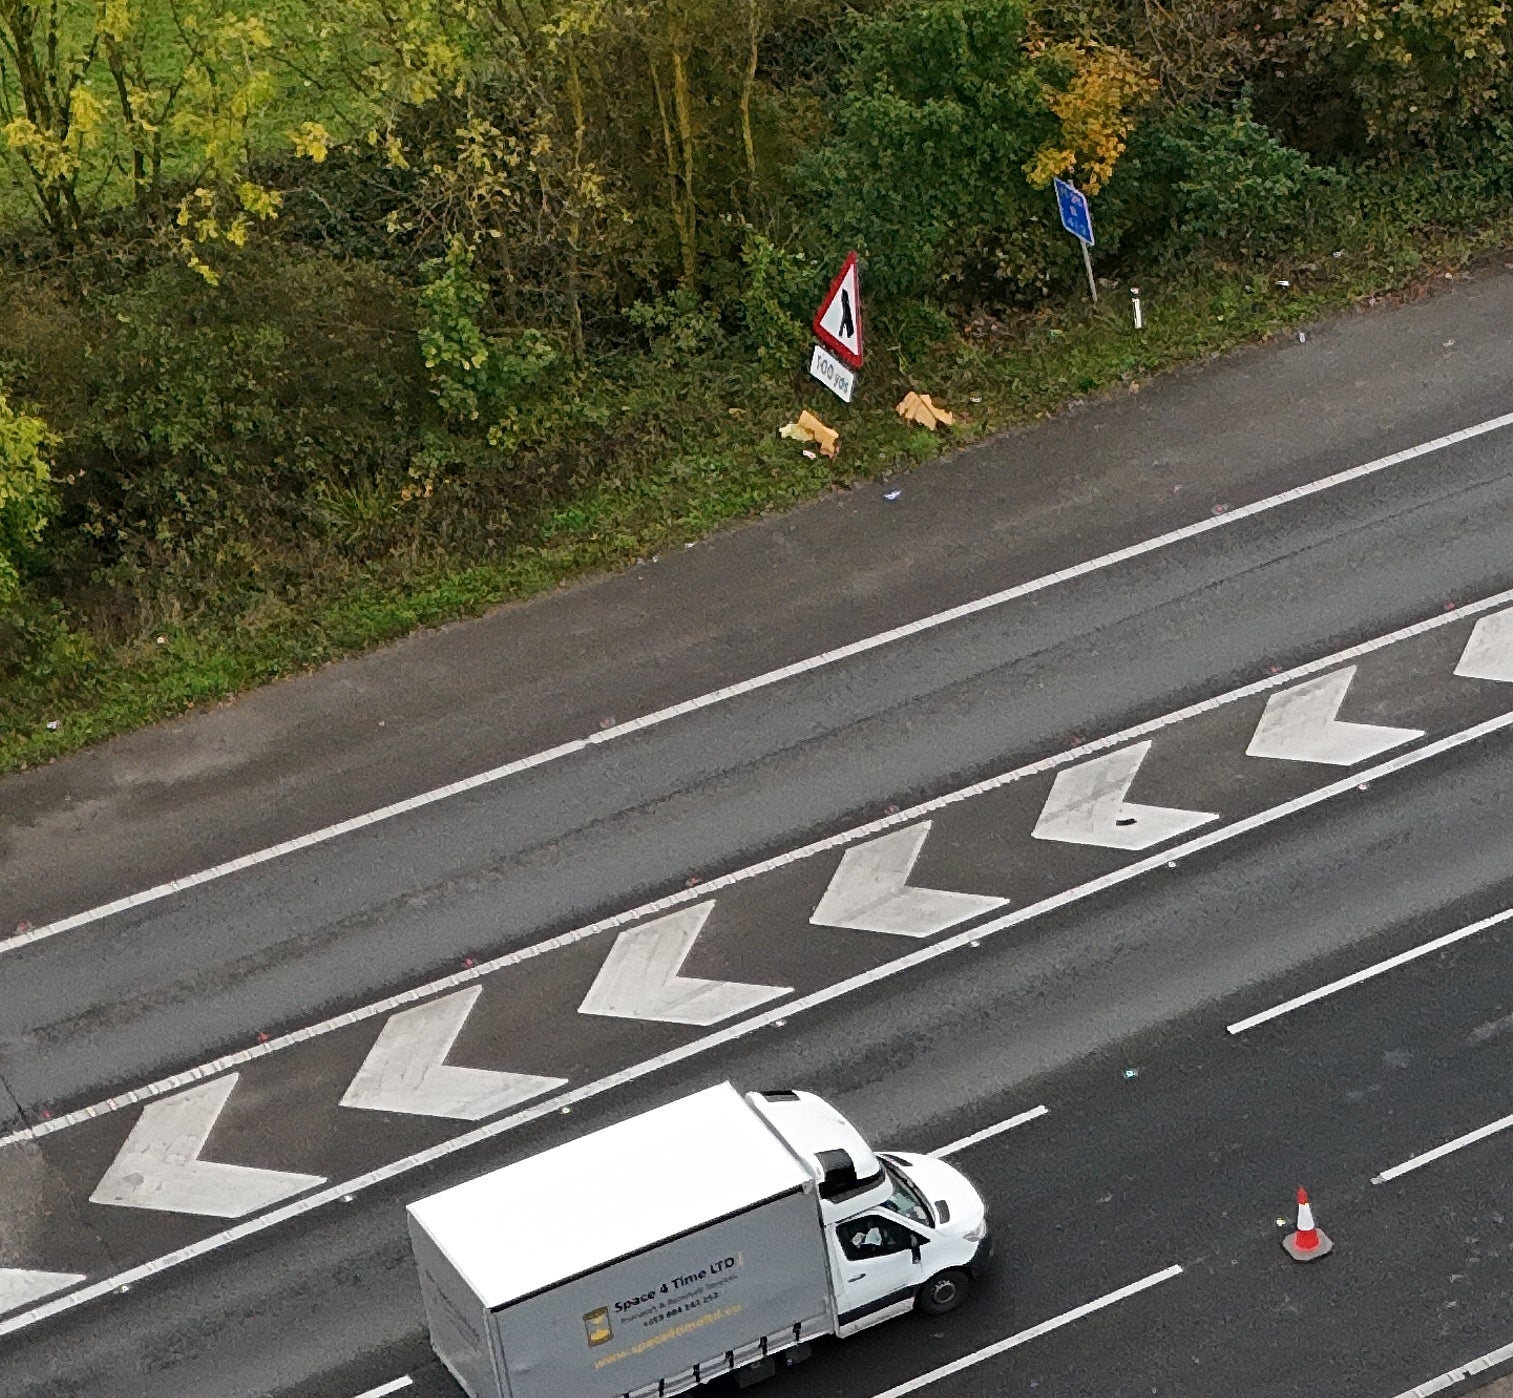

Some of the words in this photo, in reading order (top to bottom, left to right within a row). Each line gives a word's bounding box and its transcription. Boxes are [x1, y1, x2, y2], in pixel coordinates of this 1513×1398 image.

[816, 354, 834, 380] 100
[614, 1289, 656, 1313] Space
[671, 1269, 707, 1289] Time
[710, 1256, 735, 1274] LTD
